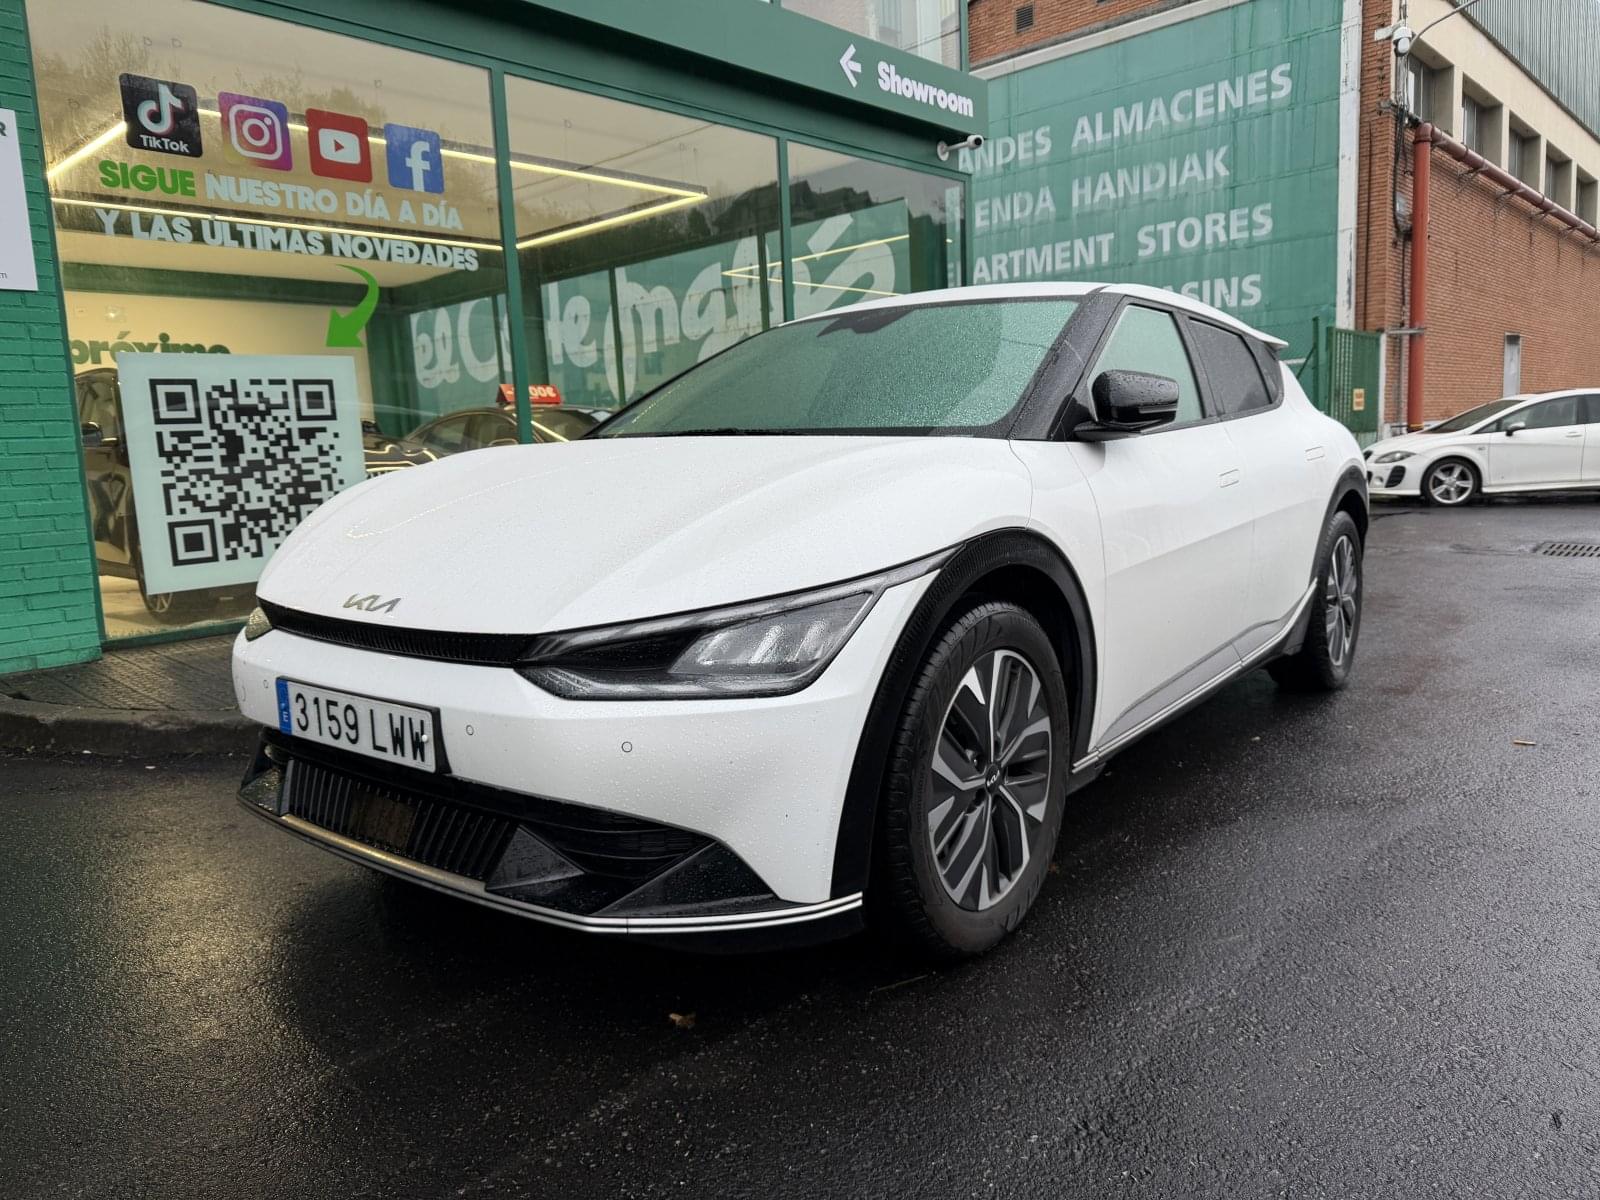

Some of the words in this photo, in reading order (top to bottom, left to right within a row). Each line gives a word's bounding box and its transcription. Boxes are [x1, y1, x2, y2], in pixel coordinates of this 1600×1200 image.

[877, 60, 974, 117] Showroom
[1071, 62, 1293, 149] ALMACENES
[139, 133, 190, 154] TikTok
[98, 160, 197, 197] SIGUE
[204, 173, 338, 215] NUESTRO
[345, 188, 390, 222] DÍA
[398, 200, 417, 225] A
[422, 200, 464, 231] DÍA
[1071, 144, 1230, 208] HANDIAK
[95, 208, 120, 237] Y
[130, 211, 194, 245] LAS
[331, 231, 480, 272] NOVEDADES
[1136, 203, 1274, 257] STORES
[295, 692, 360, 745] 3159
[369, 708, 426, 762] LWW
